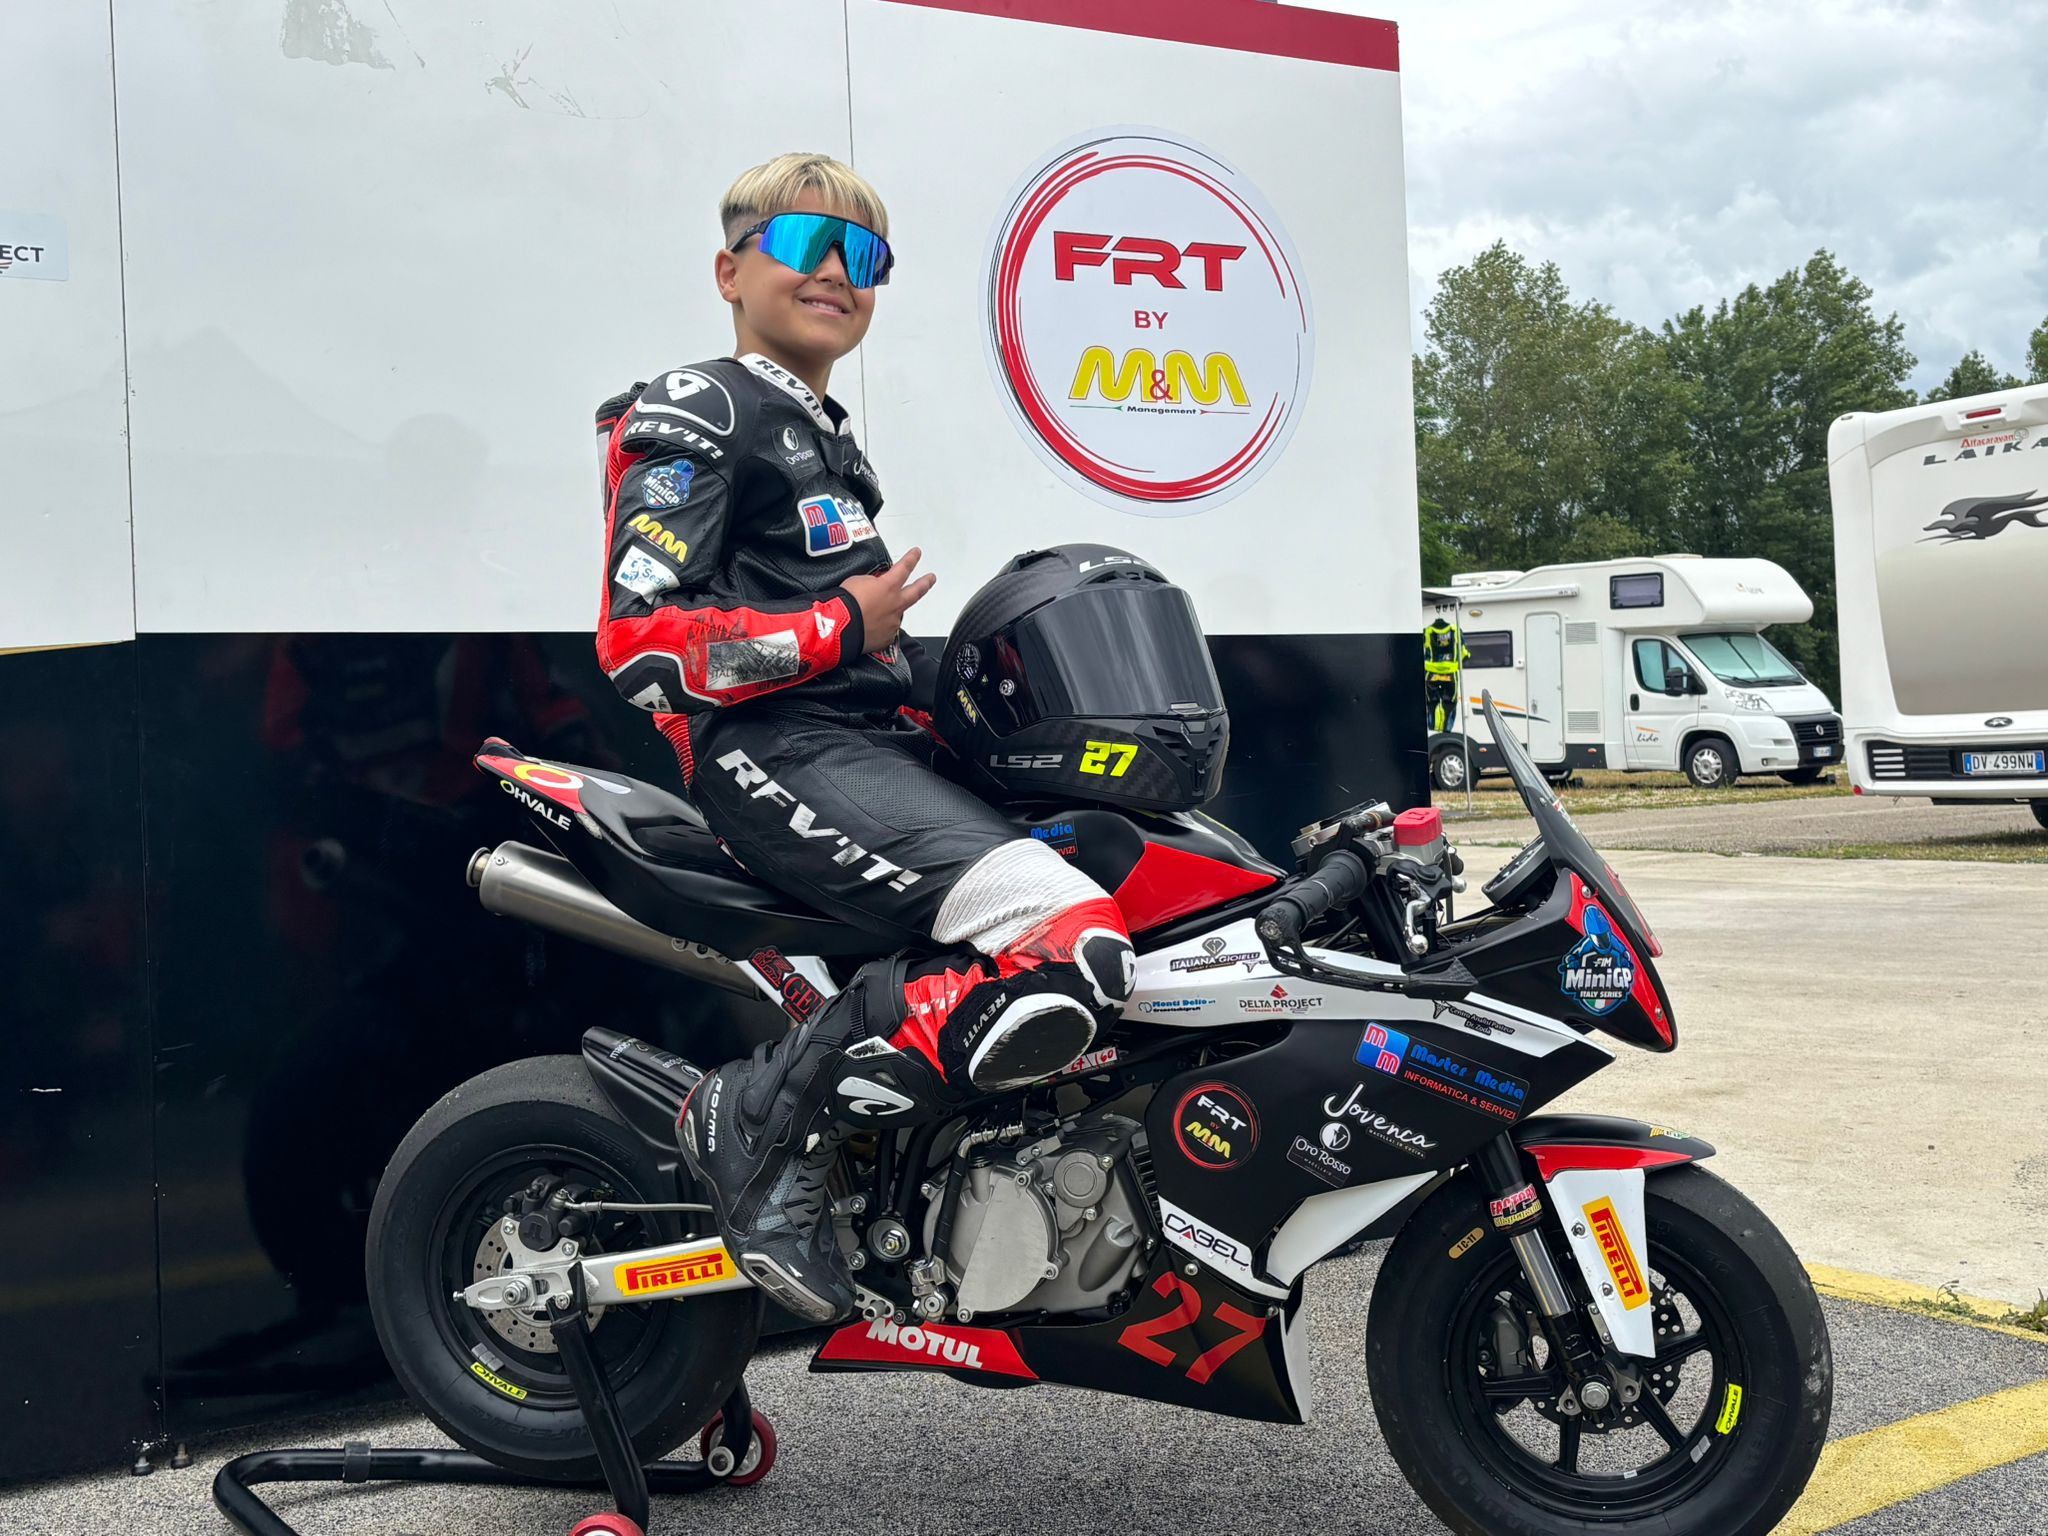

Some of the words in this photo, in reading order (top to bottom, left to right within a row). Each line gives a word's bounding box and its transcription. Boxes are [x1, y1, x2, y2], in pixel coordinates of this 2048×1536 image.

[1053, 231, 1247, 291] FRT
[1134, 310, 1168, 329] BY
[1068, 346, 1251, 406] M&M
[1126, 405, 1196, 415] Management
[624, 421, 724, 459] REV'IT!
[1923, 437, 2048, 466] LAIKA
[643, 475, 681, 505] MiniGP
[990, 754, 1063, 769] LS2
[1079, 740, 1138, 777] 27
[1973, 755, 1987, 770] DV
[1993, 754, 2034, 769] 499NW
[500, 780, 571, 830] OHVALE
[1030, 822, 1073, 840] Media
[1056, 846, 1076, 856] VIZI
[1172, 957, 1216, 970] ITALIANA
[1218, 953, 1259, 963] GIOIELLI
[1565, 967, 1632, 990] MiniGP
[1239, 1000, 1272, 1008] DELTA
[1273, 998, 1322, 1009] PROJECT
[1580, 990, 1598, 998] ITALY
[1600, 990, 1623, 998] SERIES
[1450, 1007, 1471, 1019] Centro
[1471, 1014, 1491, 1025] Analisi
[1410, 1044, 1468, 1077] Master
[1474, 1070, 1524, 1100] Media
[1197, 1094, 1247, 1131] FRT
[1404, 1070, 1468, 1102] INFORMATICA
[1470, 1096, 1478, 1105] &
[1479, 1100, 1517, 1120] SERVIZI
[1324, 1083, 1436, 1148] Jovenca
[1165, 1213, 1249, 1267] CABEL
[1590, 1207, 1643, 1297] PIRELLI
[626, 1253, 723, 1290] PIRELLI
[866, 1317, 983, 1368] MOTUL
[1117, 1271, 1267, 1385] 27
[474, 1364, 526, 1398] OHVALE
[1725, 1389, 1739, 1431] OHVALE
